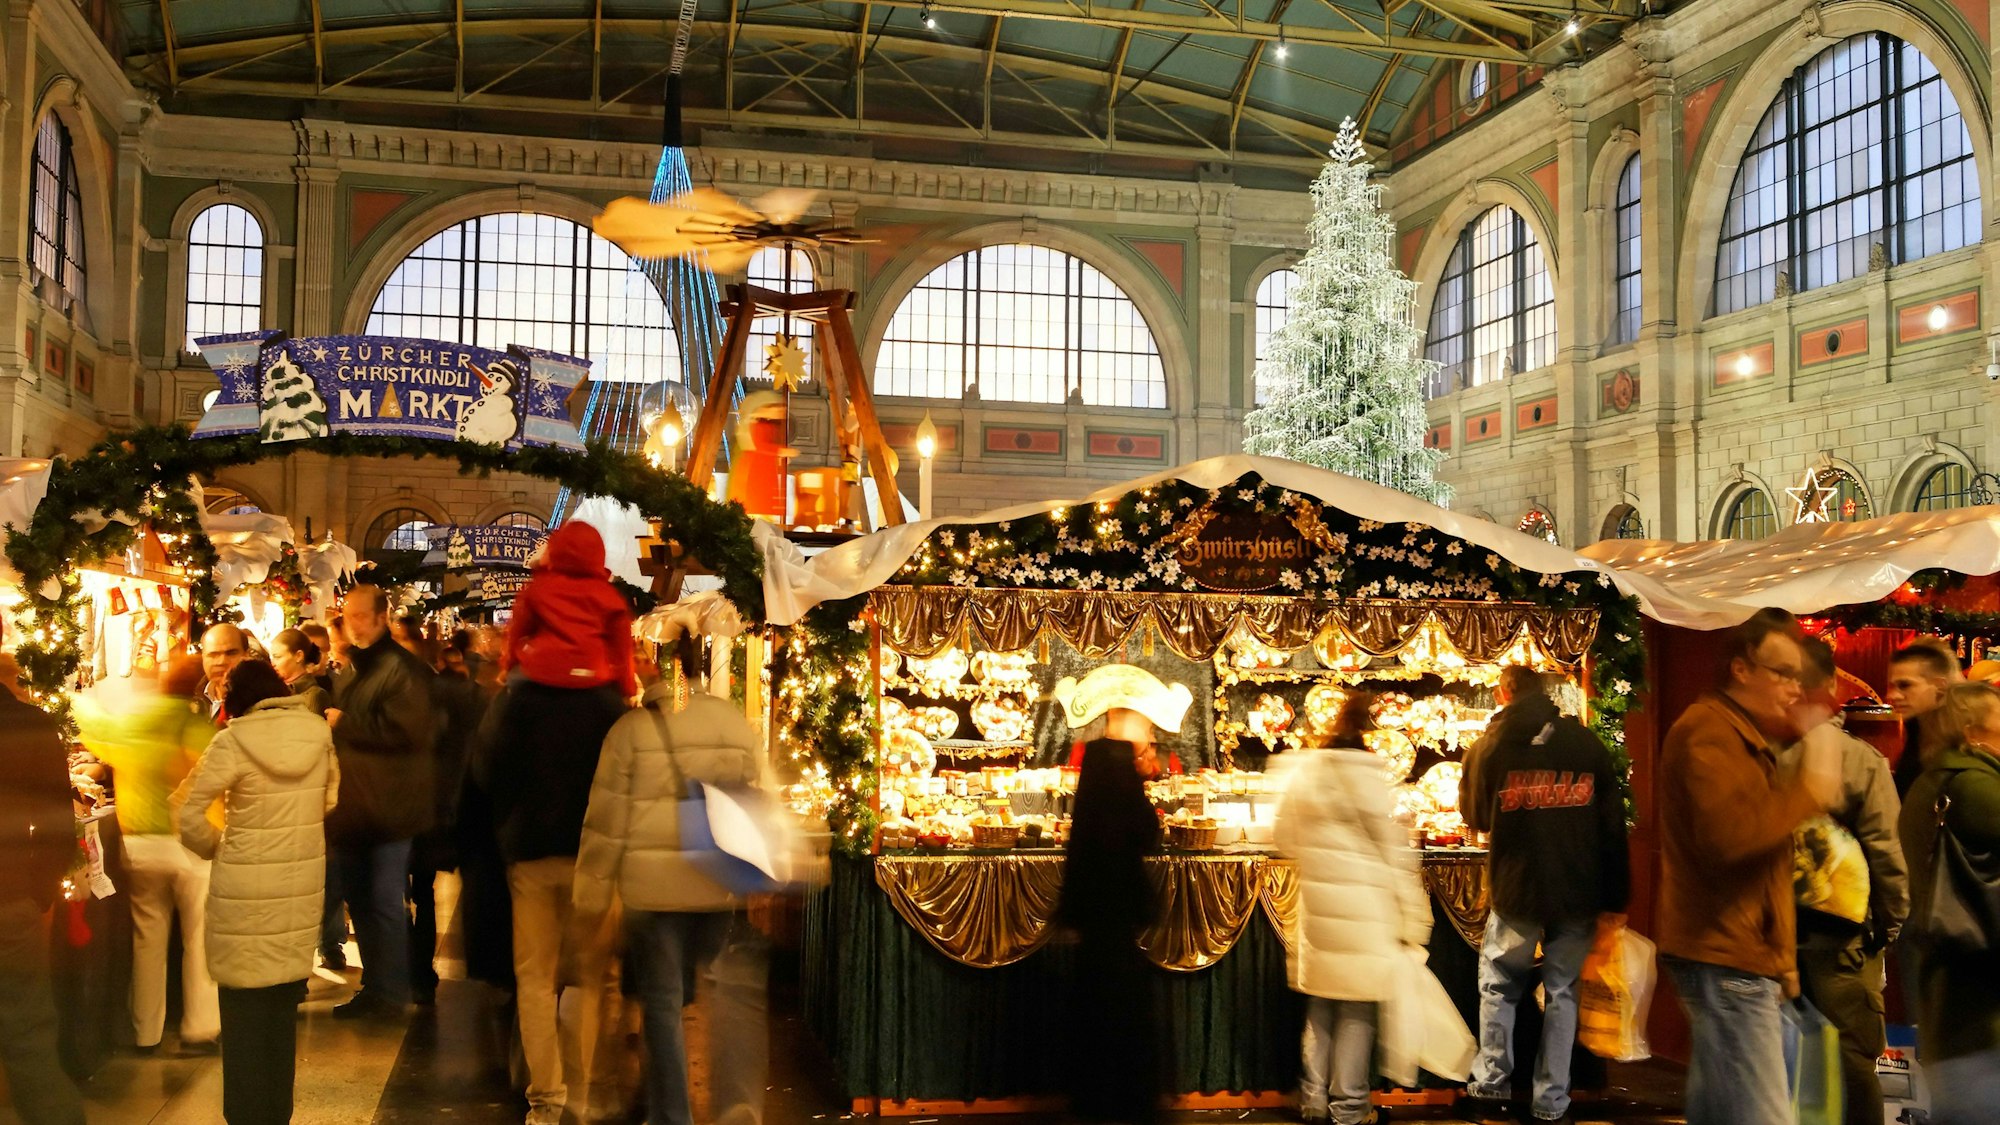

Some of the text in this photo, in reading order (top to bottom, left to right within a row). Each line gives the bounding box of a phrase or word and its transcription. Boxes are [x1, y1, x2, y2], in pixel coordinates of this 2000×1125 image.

[337, 343, 471, 368] ZÜRCHER
[337, 366, 470, 388] CHRISTKINDLI
[475, 528, 529, 538] ZÜRCHER
[475, 536, 530, 545] CHRISTKINDLI
[1498, 771, 1594, 812] BULLS
